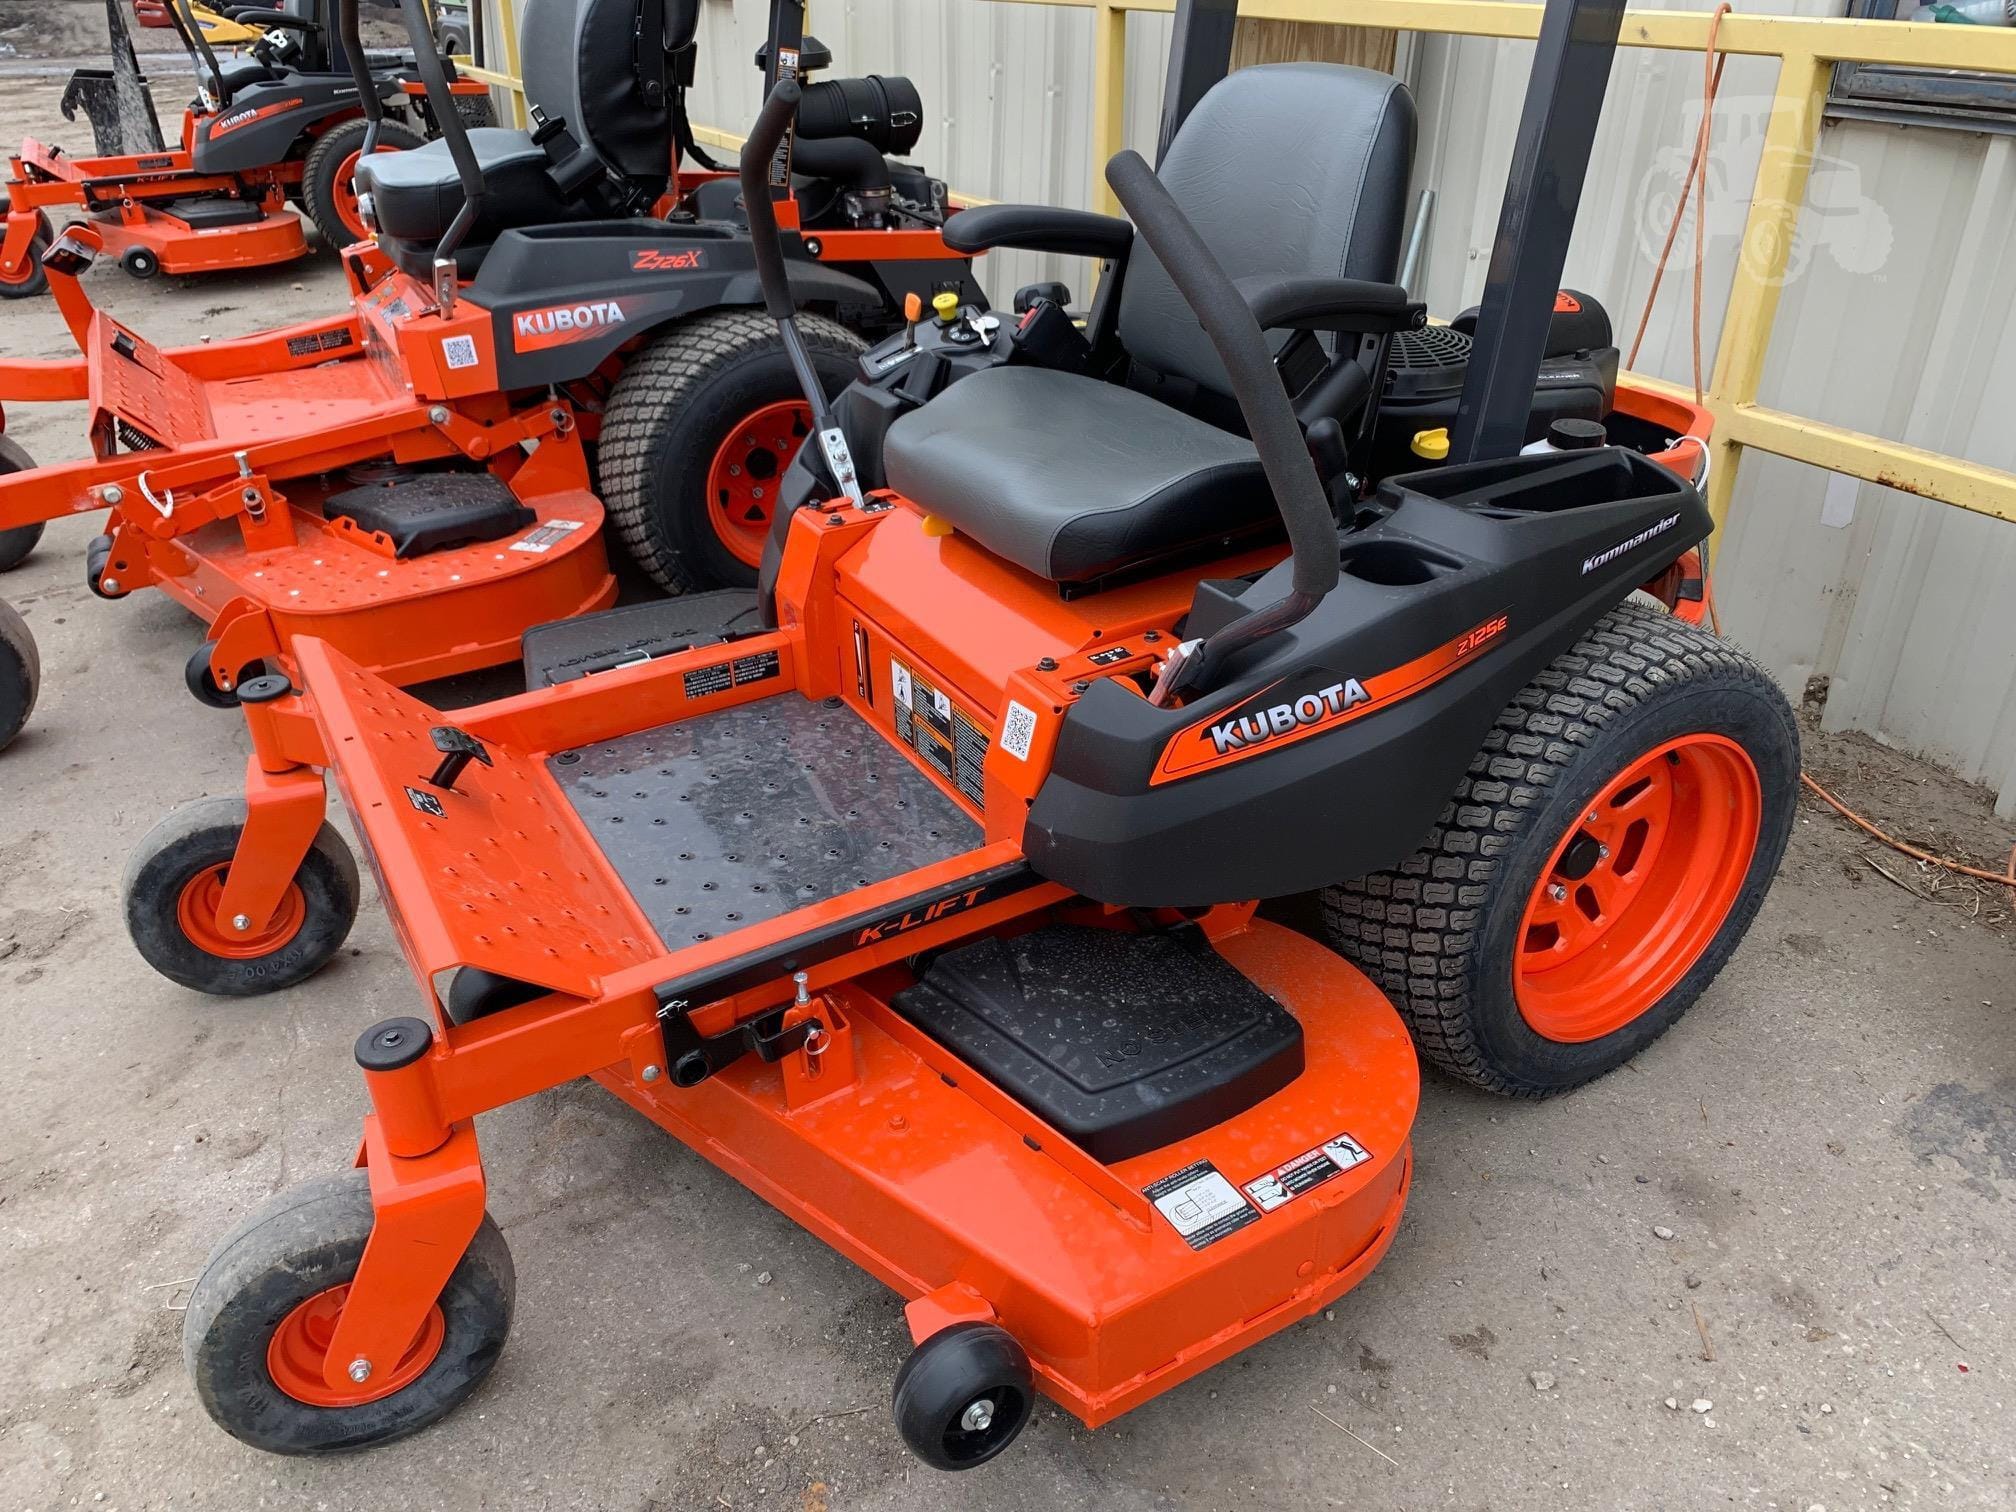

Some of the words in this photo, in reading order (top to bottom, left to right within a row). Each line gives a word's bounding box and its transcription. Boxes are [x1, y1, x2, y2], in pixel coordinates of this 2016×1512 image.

[220, 108, 258, 128] KUBOTA
[633, 250, 702, 270] Z726X
[517, 302, 627, 337] KUBOTA
[1581, 512, 1681, 577] Kommander
[1456, 614, 1509, 657] Z125E
[1211, 678, 1371, 754] KUBOTA
[857, 886, 986, 946] K-LIFT
[1095, 1039, 1142, 1068] NO
[1168, 1167, 1187, 1179] ROLLER
[1283, 1150, 1320, 1171] DANGER
